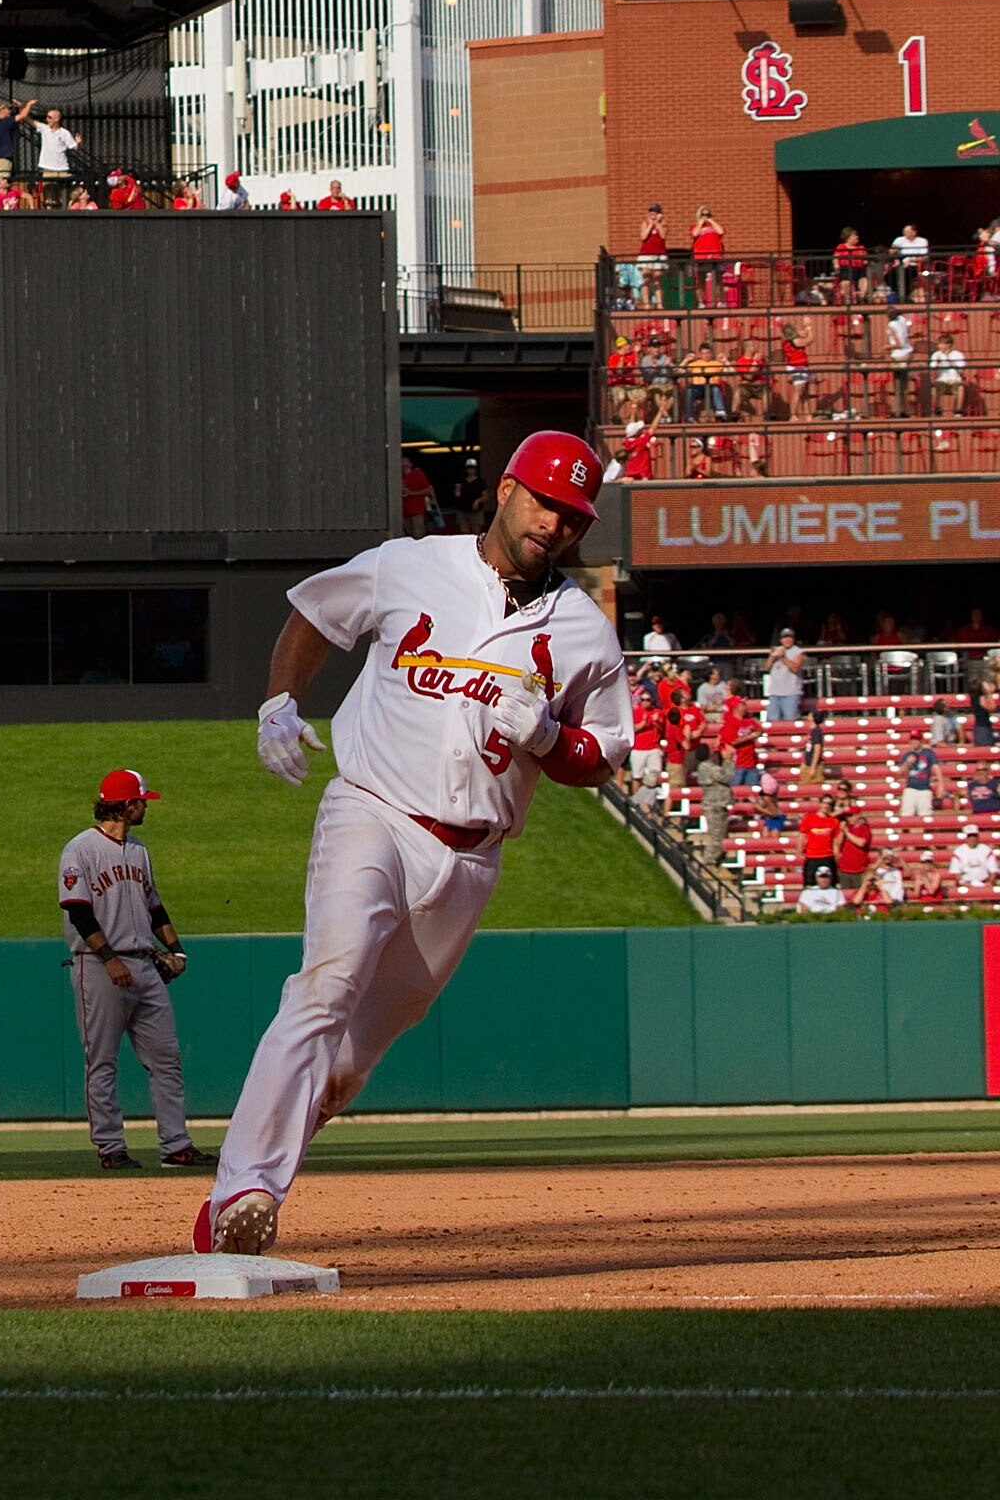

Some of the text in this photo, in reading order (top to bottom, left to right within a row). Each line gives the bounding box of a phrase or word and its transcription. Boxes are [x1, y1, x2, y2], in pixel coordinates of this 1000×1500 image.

[898, 36, 926, 115] 1
[407, 649, 504, 709] Cardin
[91, 870, 113, 897] SAN
